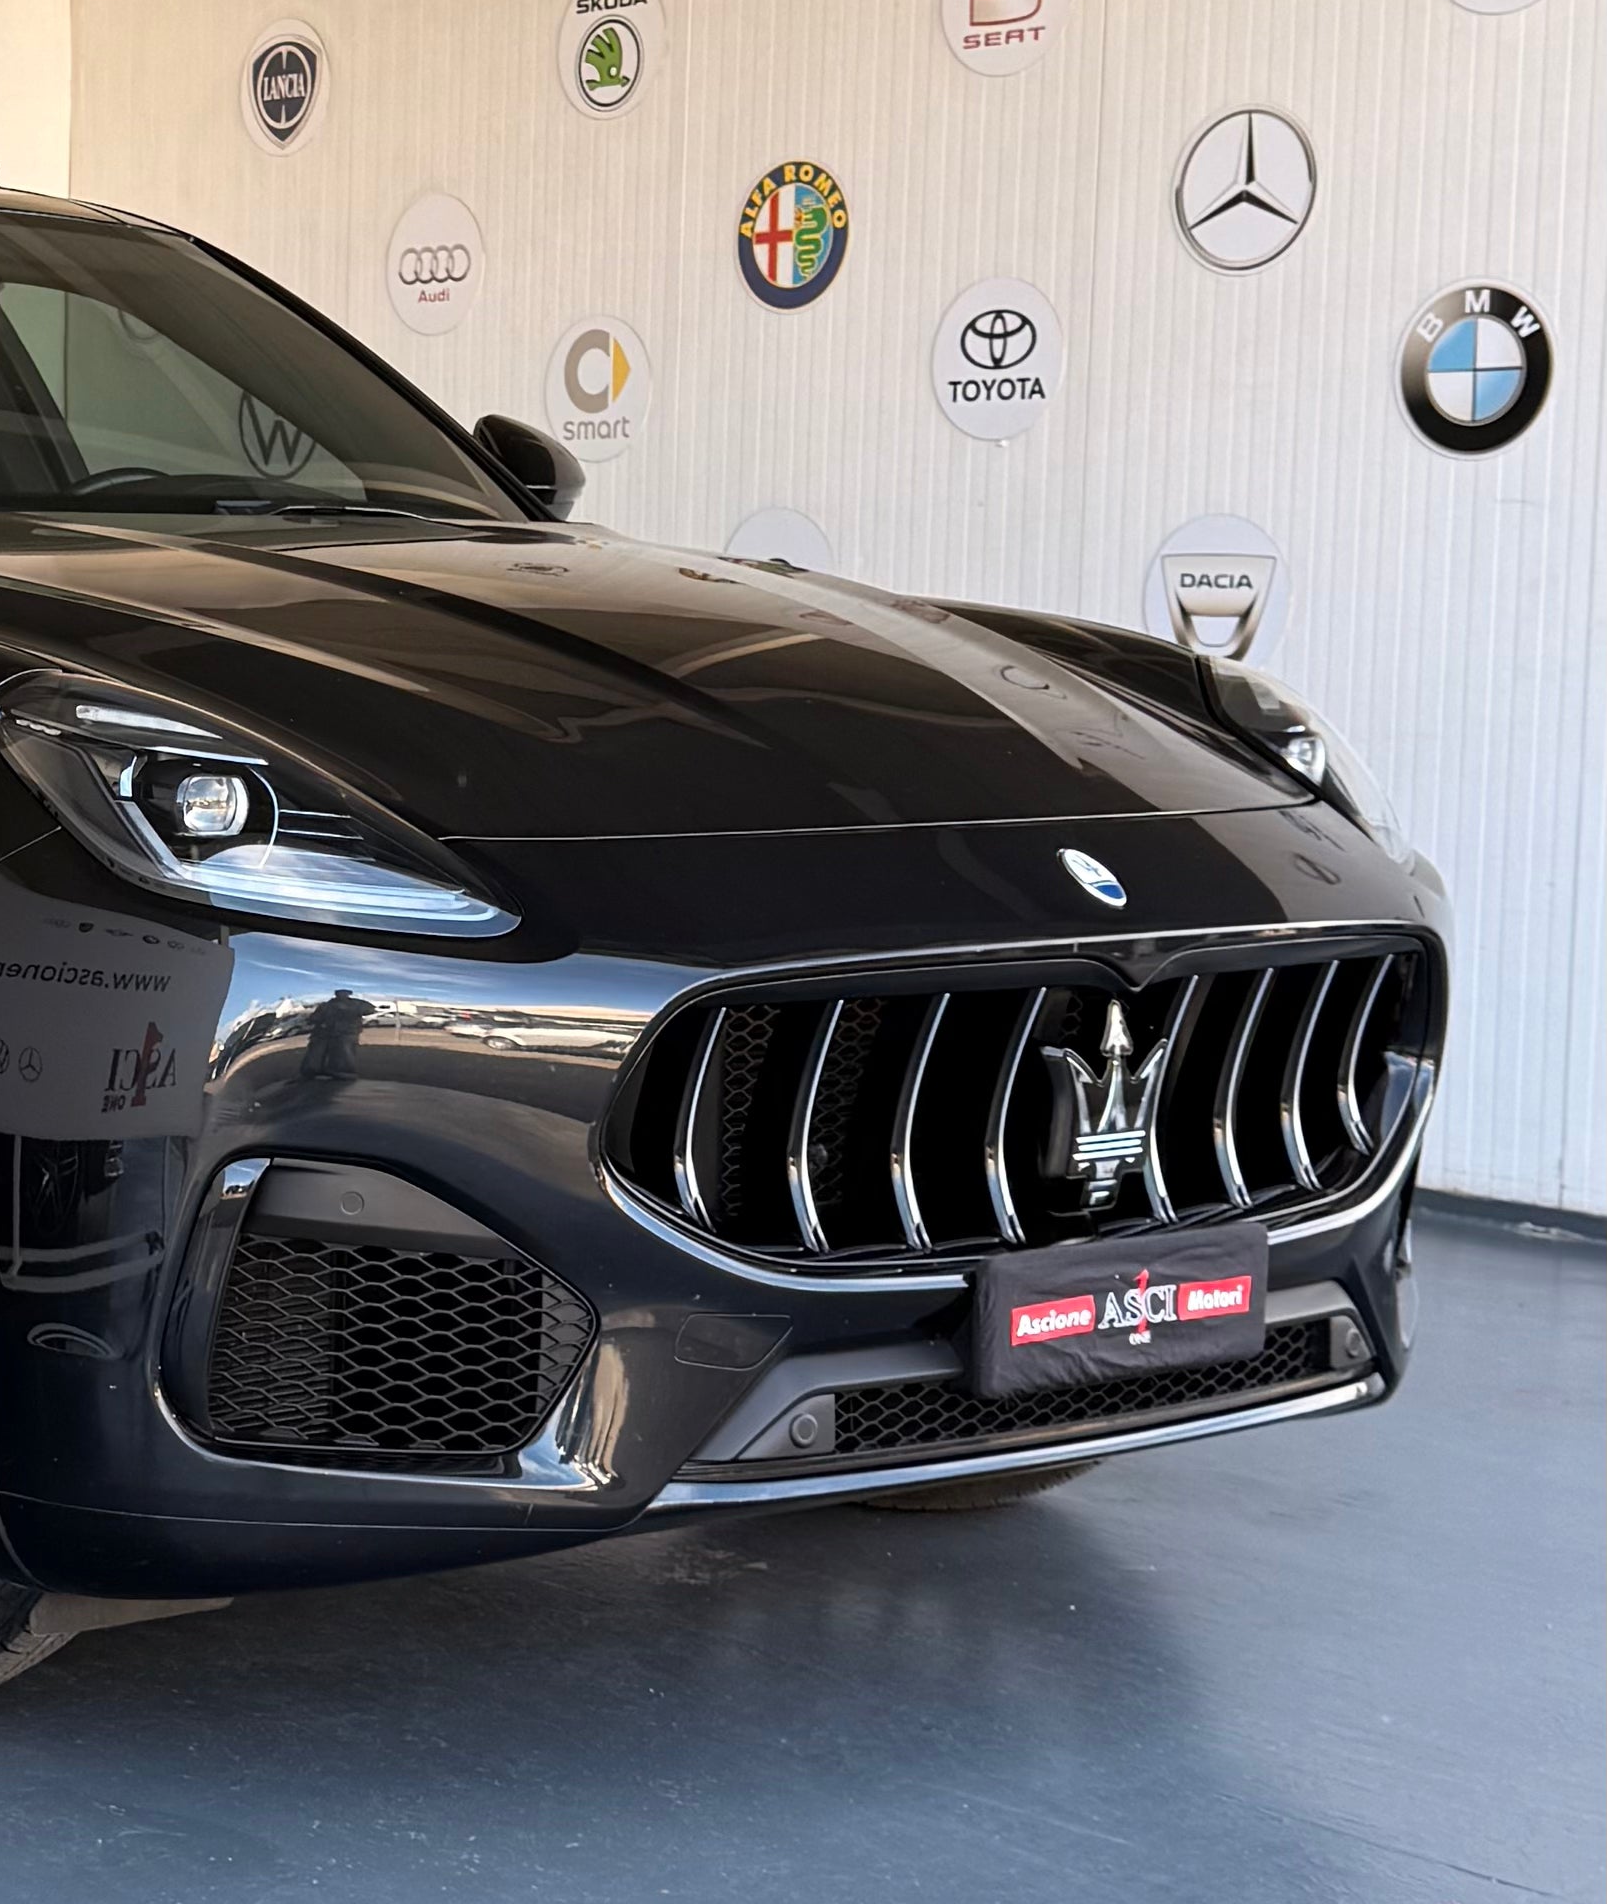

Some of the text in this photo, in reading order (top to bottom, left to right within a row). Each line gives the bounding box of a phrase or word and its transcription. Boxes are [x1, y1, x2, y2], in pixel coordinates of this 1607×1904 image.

[962, 26, 1046, 49] SEAT
[262, 72, 306, 101] LANCIA
[740, 164, 847, 239] ALFA ROMEO
[417, 288, 451, 303] Audi
[1416, 289, 1541, 343] BMW
[947, 377, 1046, 403] TOYOTA
[562, 416, 631, 441] smart
[1179, 572, 1254, 590] DACIA
[1015, 1283, 1244, 1337] Ascione ASCI Motori
